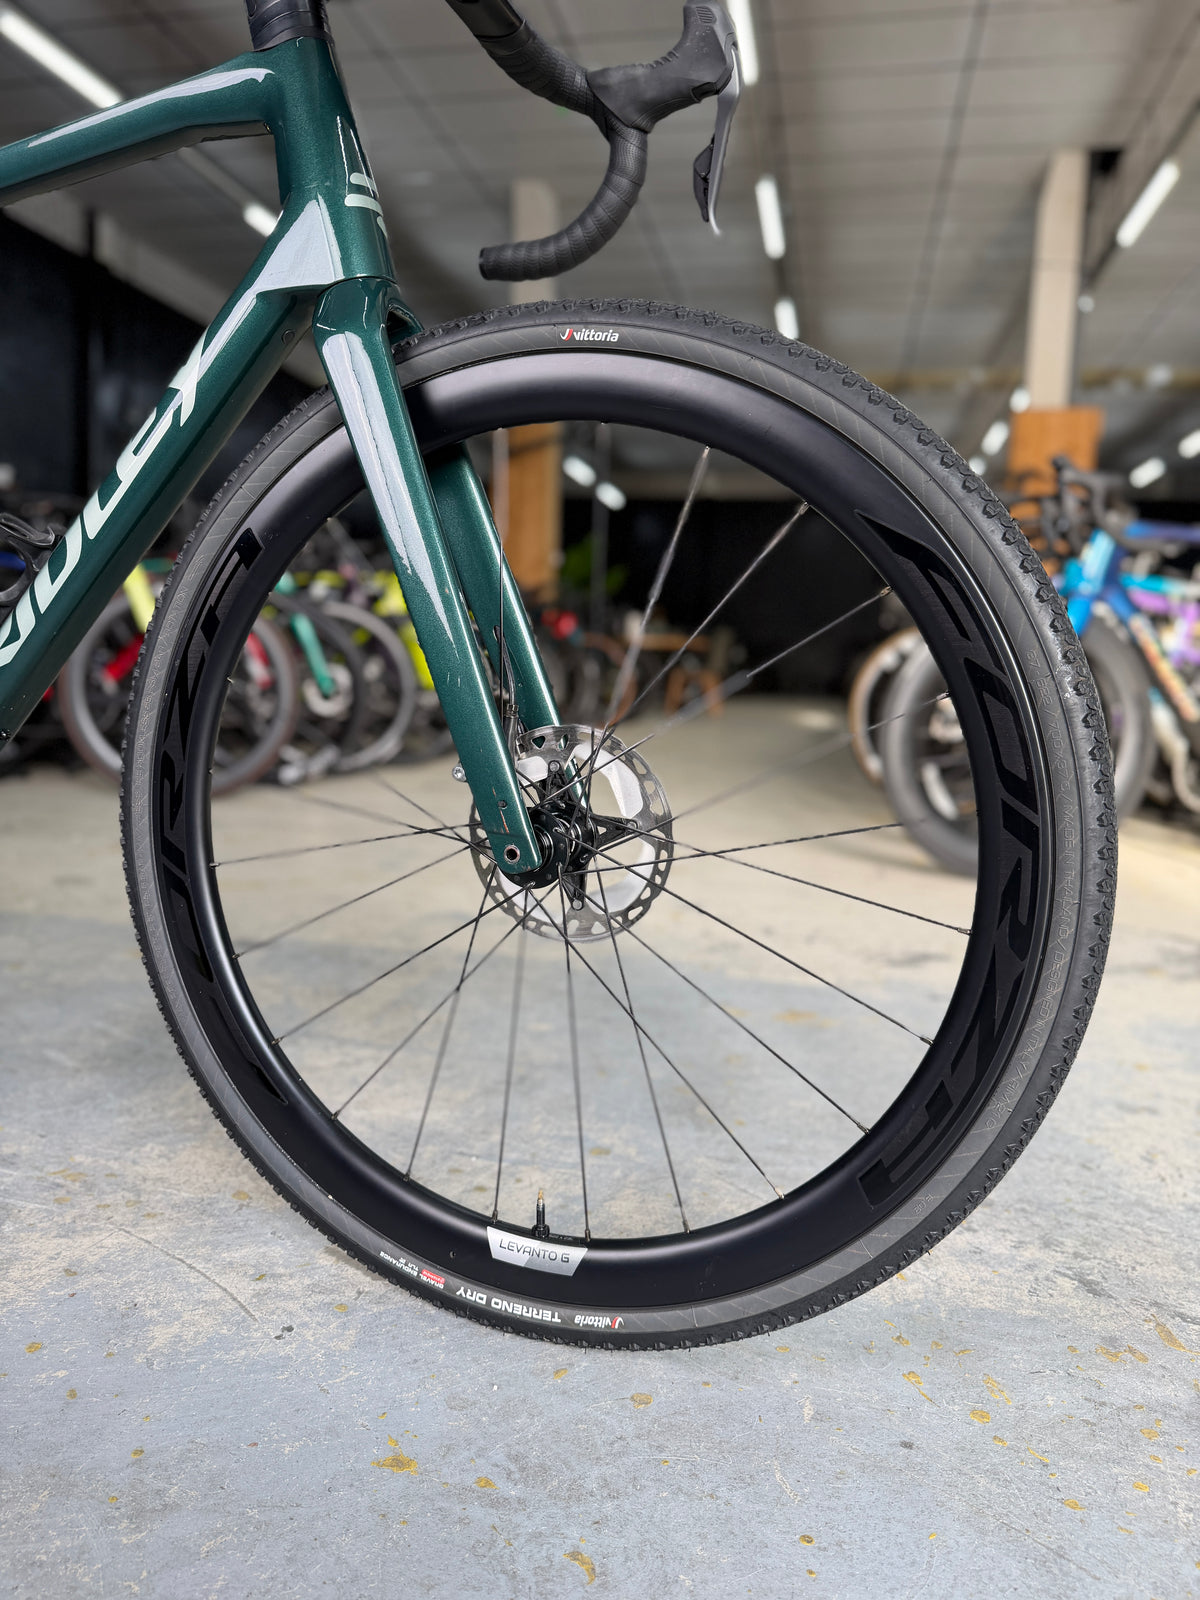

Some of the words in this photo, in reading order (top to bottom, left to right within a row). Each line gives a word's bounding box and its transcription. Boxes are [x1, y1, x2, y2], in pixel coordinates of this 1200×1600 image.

[573, 328, 619, 342] vittoria
[499, 1238, 558, 1261] LEVANTO
[560, 1252, 571, 1263] G
[456, 1286, 487, 1305] DRY
[491, 1298, 562, 1323] TERRENO
[574, 1314, 611, 1329] vittoria
